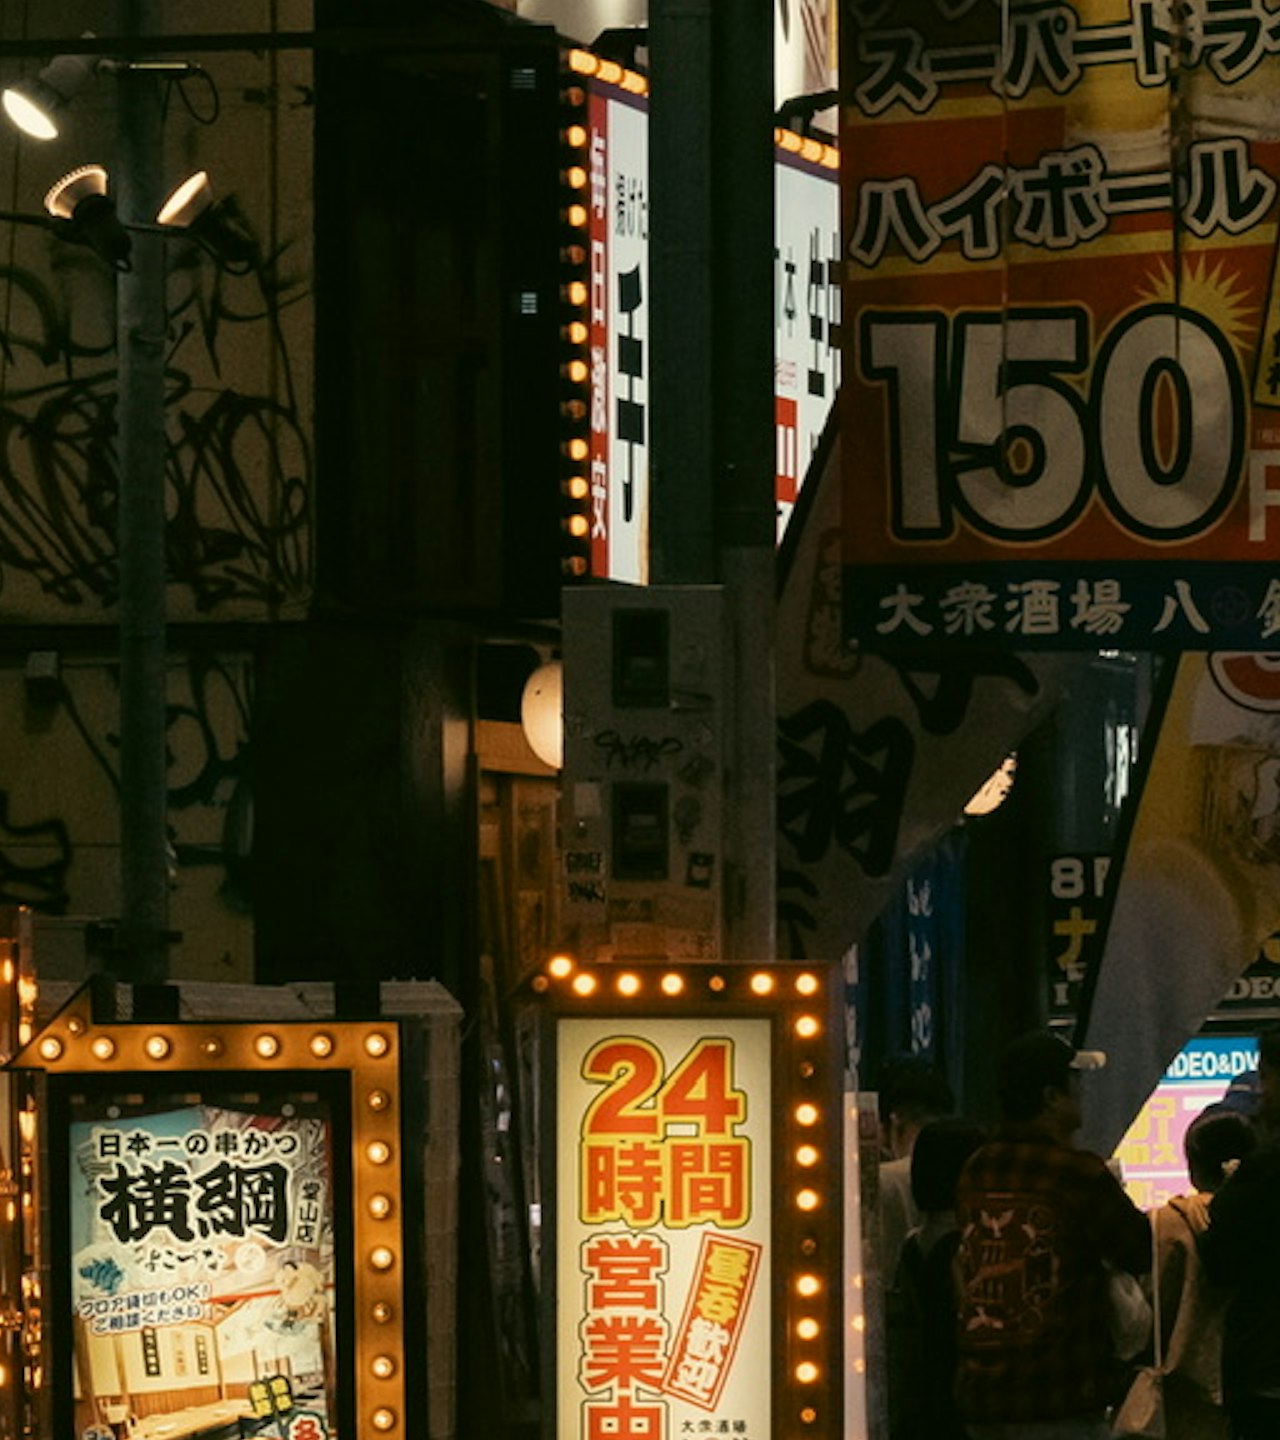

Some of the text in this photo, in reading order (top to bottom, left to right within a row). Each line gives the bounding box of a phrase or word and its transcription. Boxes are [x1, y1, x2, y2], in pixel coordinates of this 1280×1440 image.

[849, 137, 1280, 266] ハイボール
[875, 578, 1133, 637] 大衆酒場
[99, 1132, 298, 1157] 日本一の串かつ
[99, 1160, 289, 1244] 横綱
